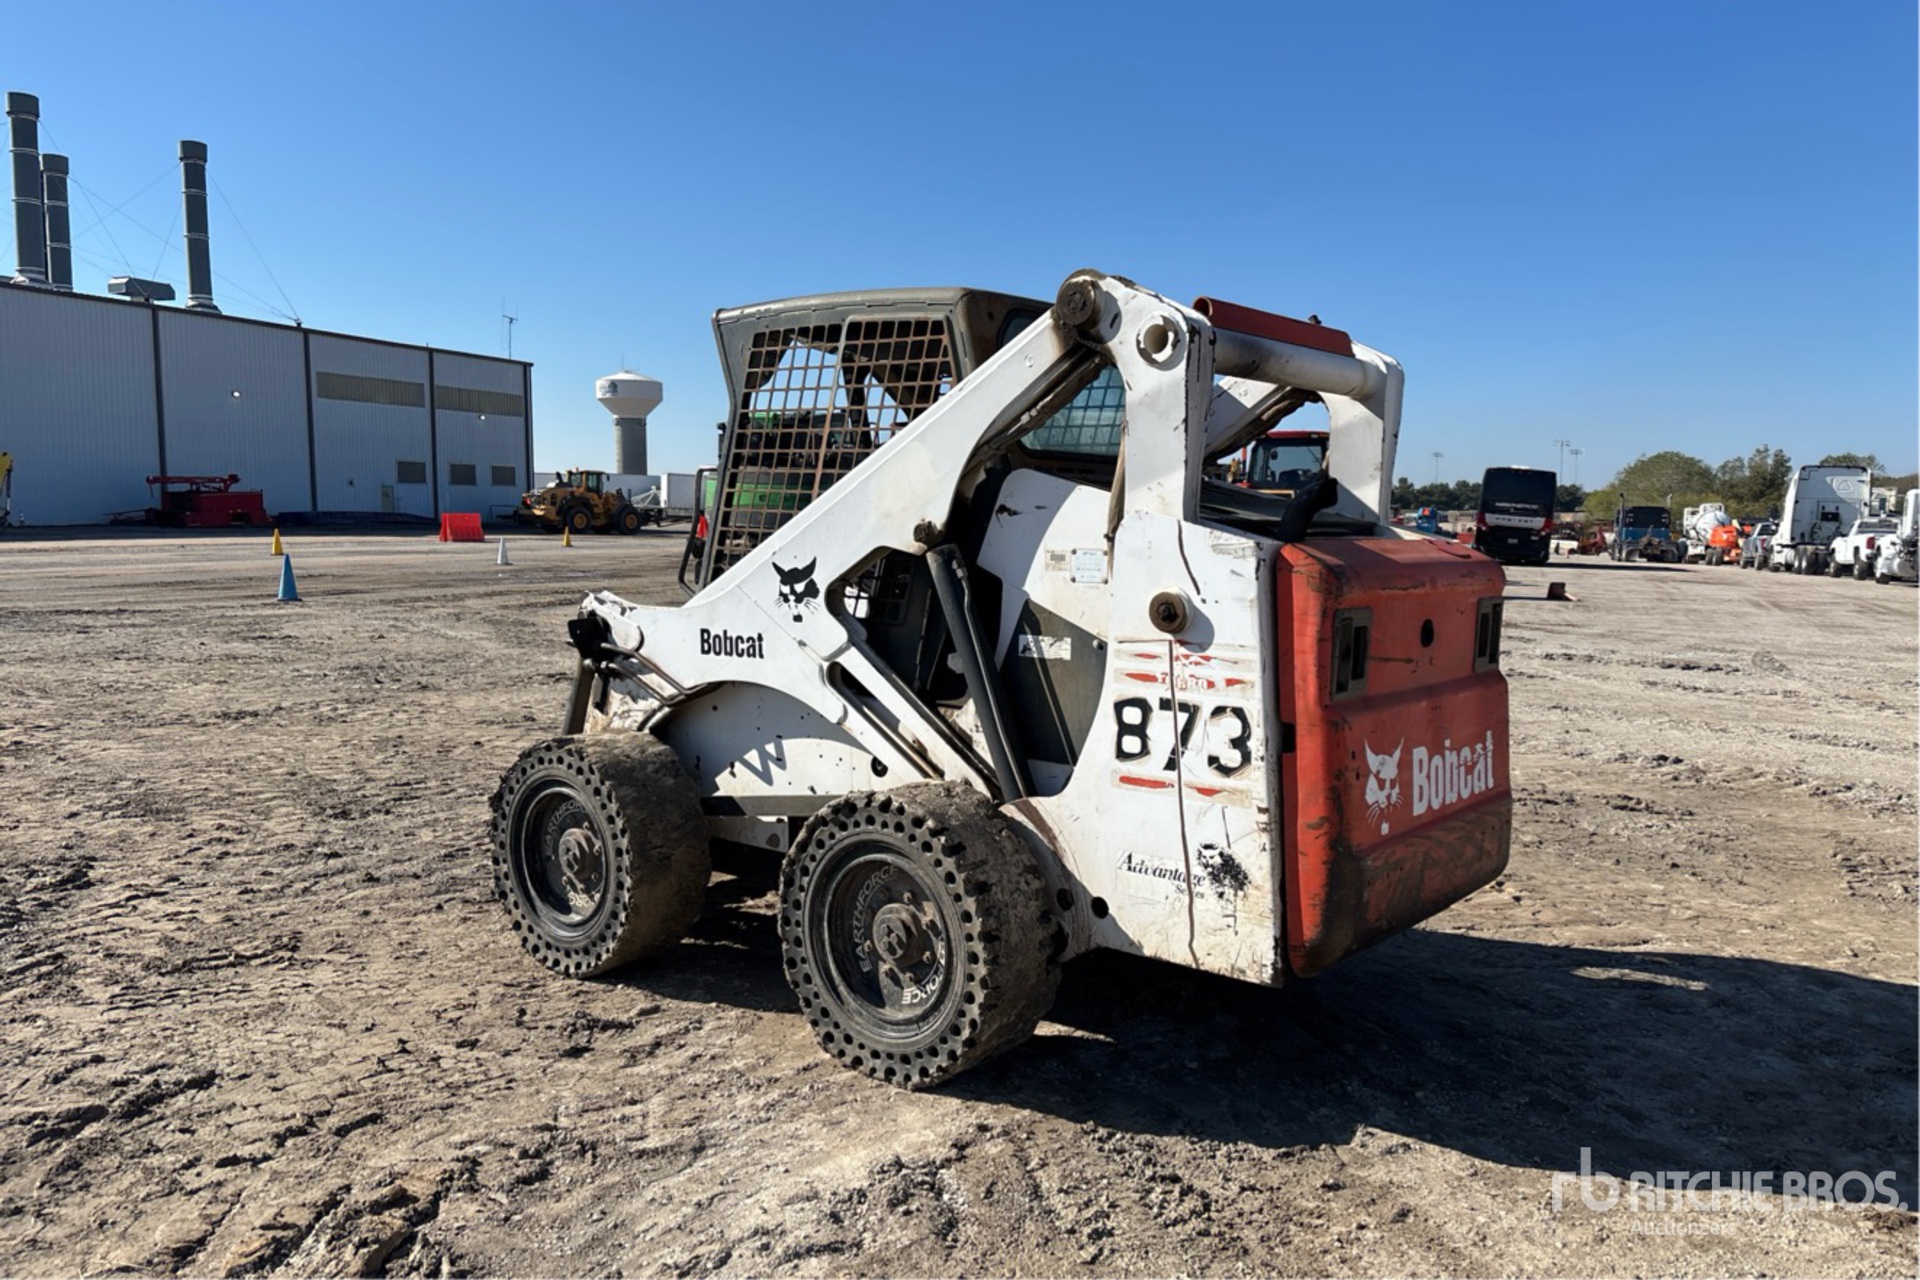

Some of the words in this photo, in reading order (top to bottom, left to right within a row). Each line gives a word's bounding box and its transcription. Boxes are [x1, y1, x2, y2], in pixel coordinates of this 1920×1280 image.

[700, 627, 764, 659] Bobcat
[1114, 697, 1252, 778] 873
[1412, 730, 1494, 816] Bobcat
